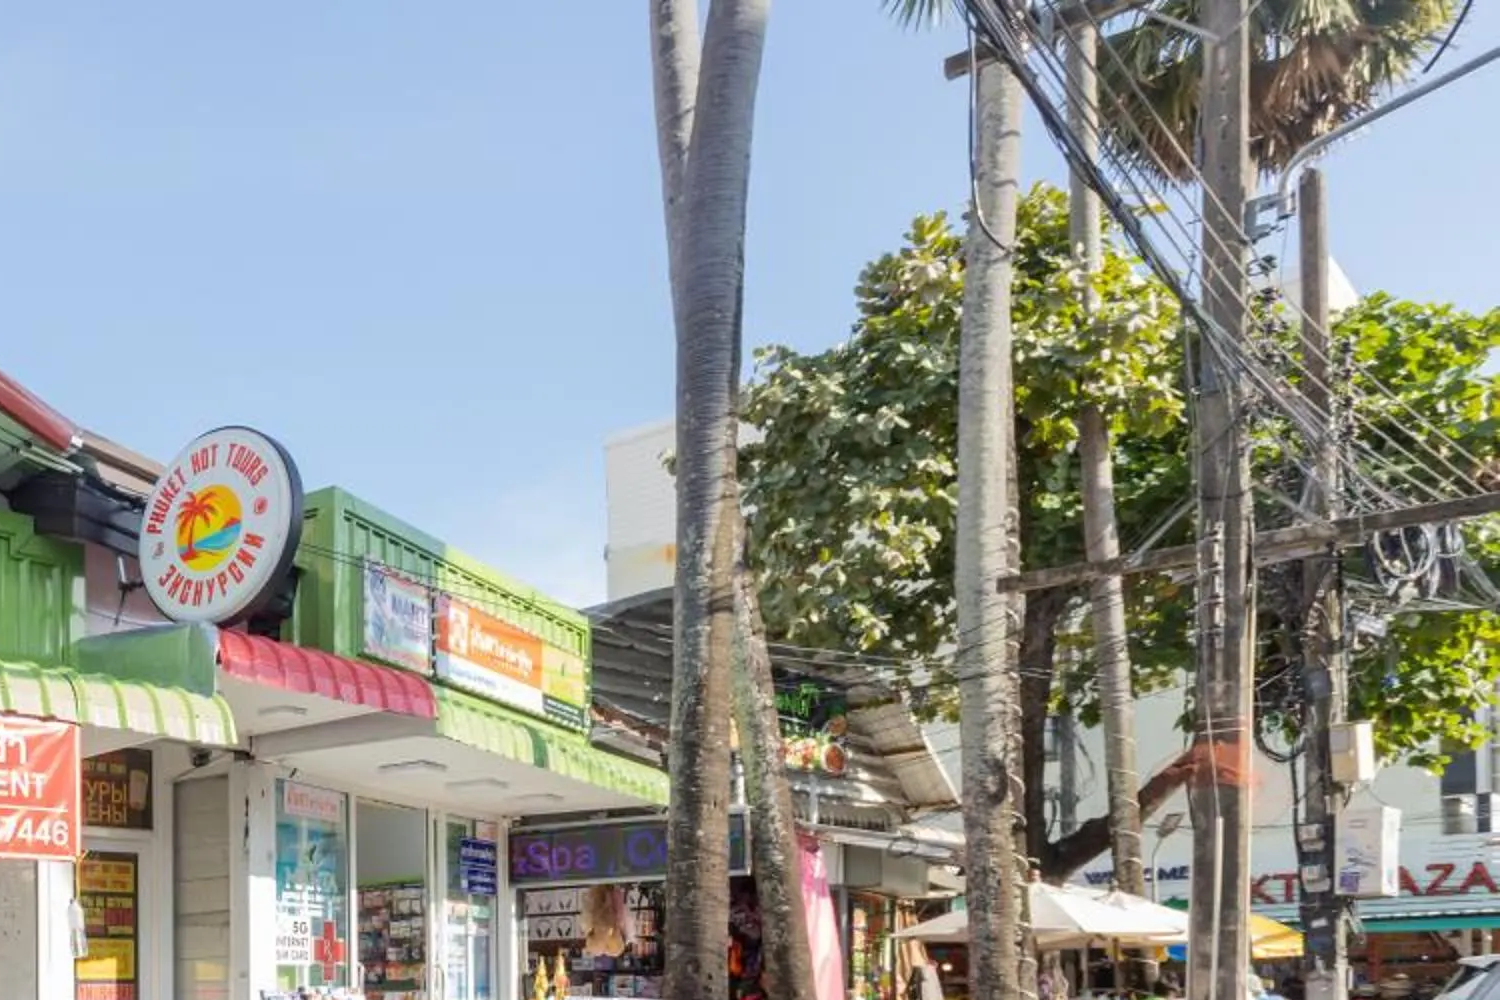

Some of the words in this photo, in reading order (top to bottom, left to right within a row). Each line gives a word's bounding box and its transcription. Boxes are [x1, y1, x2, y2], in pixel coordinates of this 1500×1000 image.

[190, 443, 219, 475] HOT
[86, 779, 127, 805] УРЫ
[86, 804, 127, 824] ЕНЫ
[526, 840, 596, 880] Spa
[1084, 866, 1189, 885] WEOME
[1398, 861, 1498, 896] AZA
